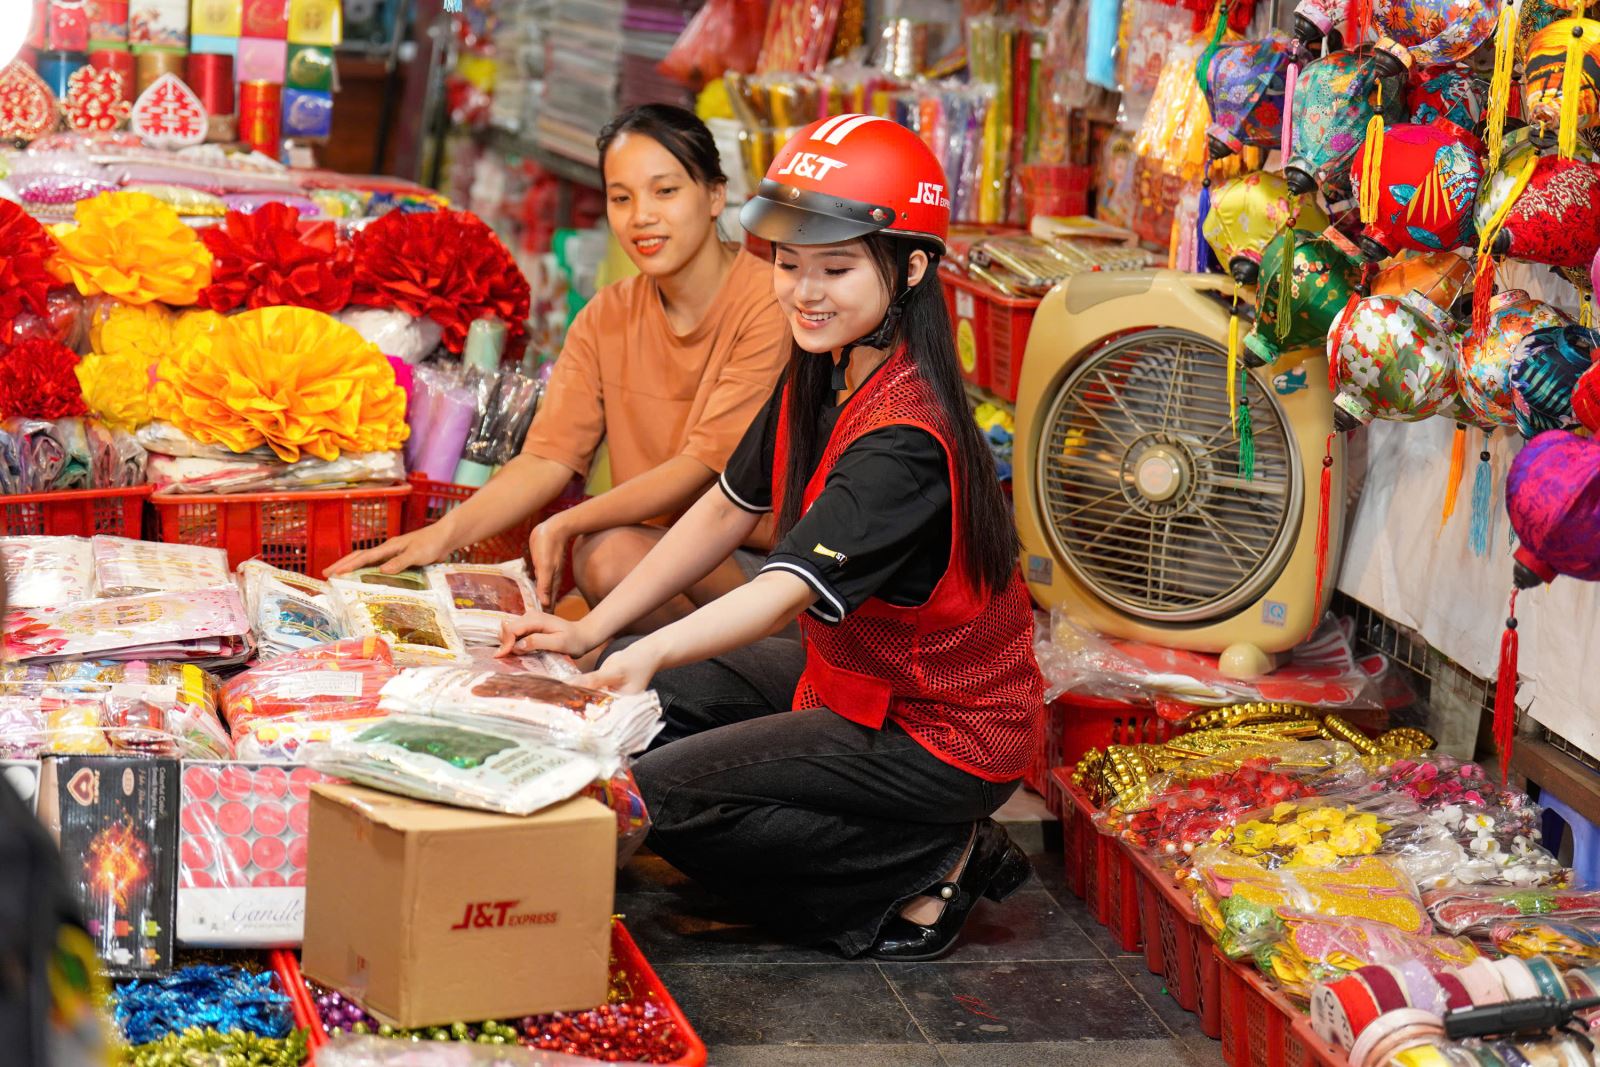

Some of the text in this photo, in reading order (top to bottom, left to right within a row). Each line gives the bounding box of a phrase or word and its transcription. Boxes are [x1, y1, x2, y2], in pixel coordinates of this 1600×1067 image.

[777, 152, 848, 181] J&T
[909, 181, 944, 206] J&T
[231, 898, 304, 923] Candle
[451, 900, 559, 930] J&T EXPRESS
